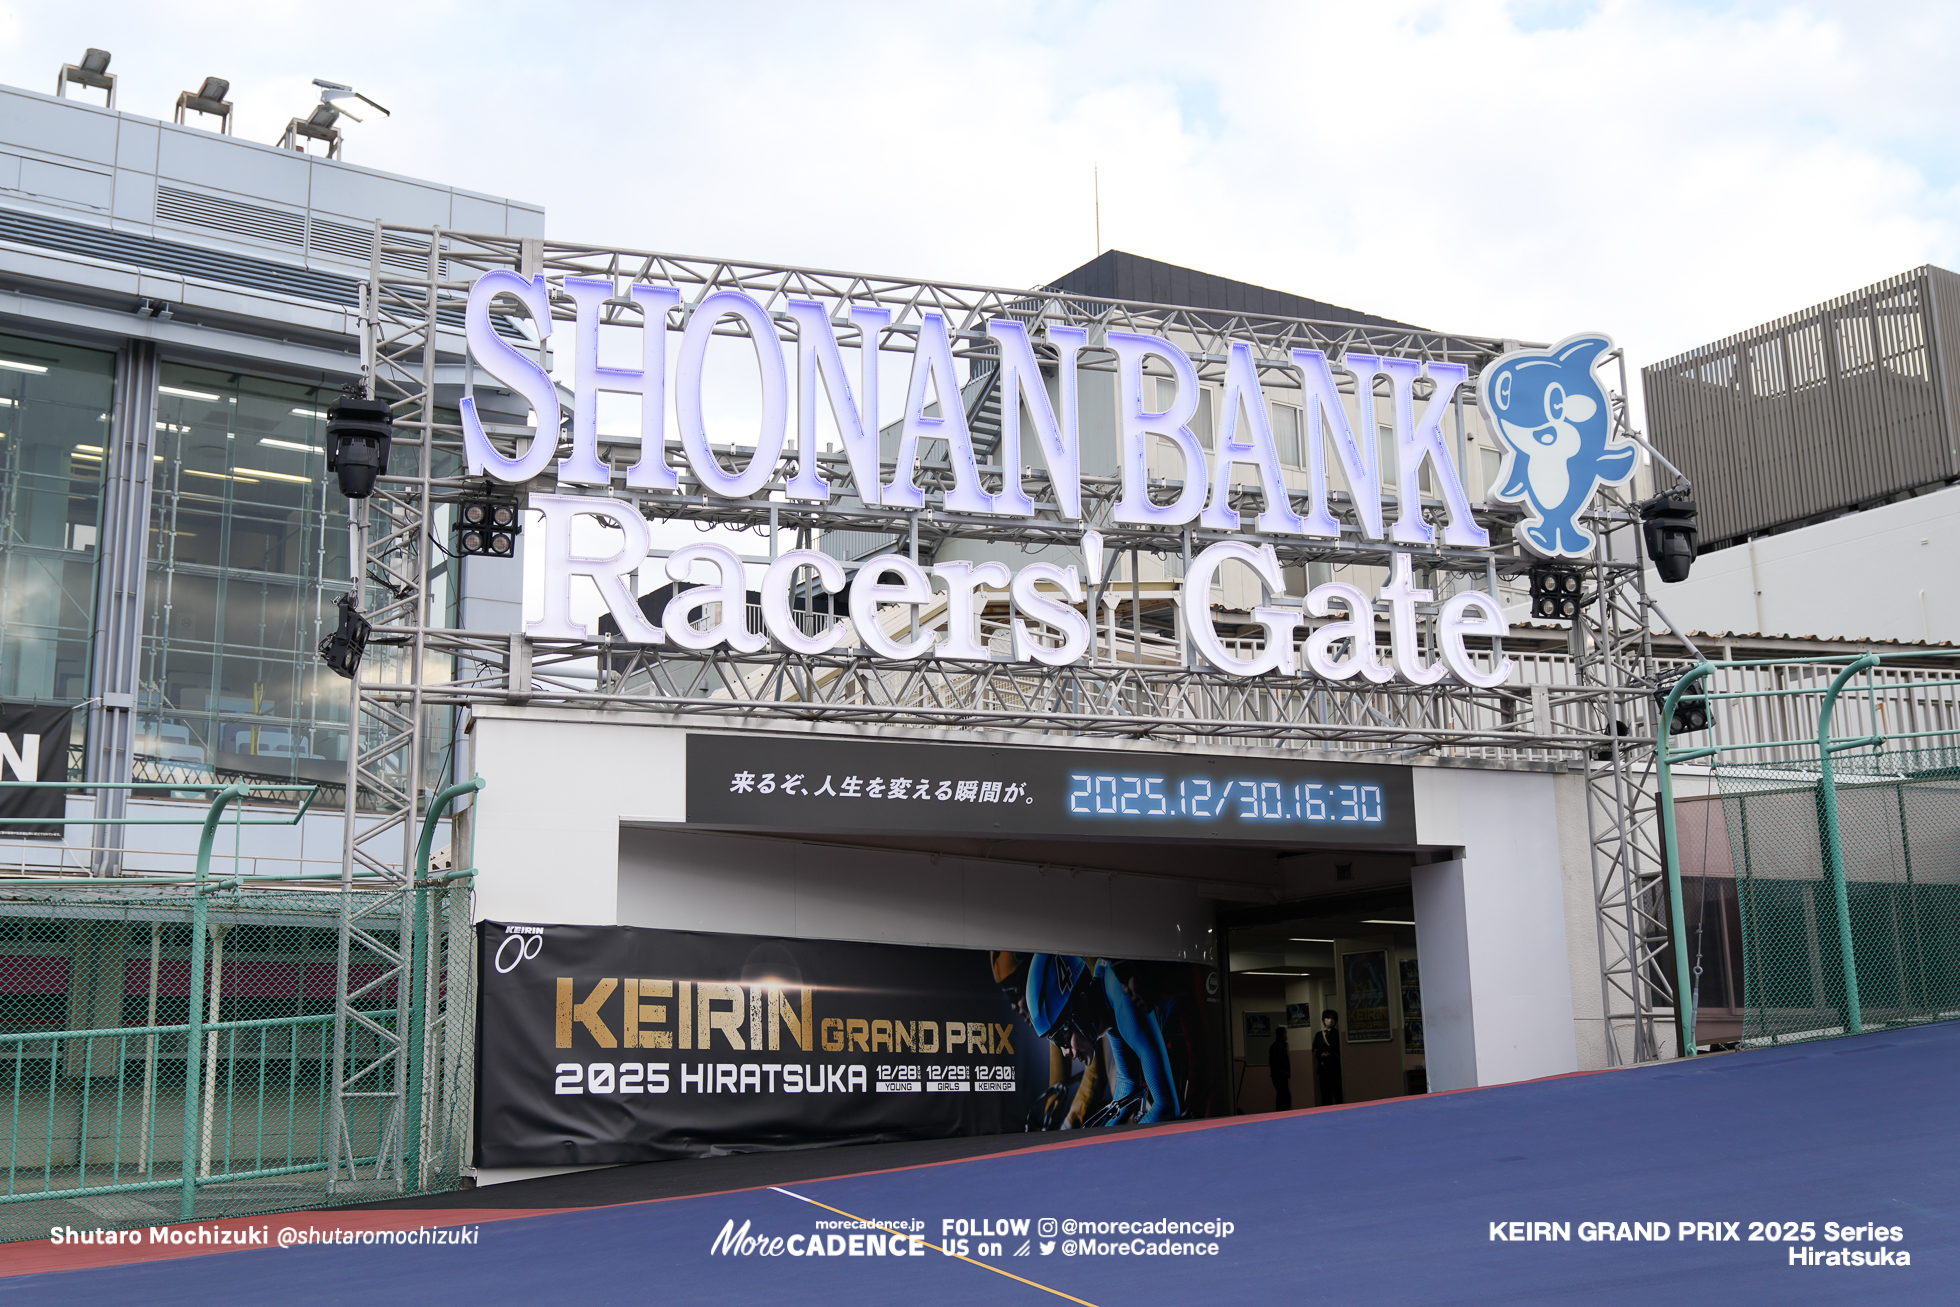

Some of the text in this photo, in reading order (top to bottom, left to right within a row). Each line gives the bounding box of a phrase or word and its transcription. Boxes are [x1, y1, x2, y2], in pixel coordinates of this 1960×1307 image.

[460, 268, 1490, 548] SHONAN BANK
[525, 492, 1515, 689] Racers' Gate
[730, 771, 1033, 805] 来るぞ、人生を変える瞬間が。
[505, 926, 544, 934] KEIRIN
[555, 976, 1015, 1055] KEIRIN GRAND PRIX
[555, 1062, 867, 1094] 2025 HIRATSUKA
[876, 1065, 917, 1080] 12/28
[926, 1065, 966, 1080] 12/29
[974, 1065, 1011, 1080] 12/30
[885, 1082, 912, 1091] YOUNG
[937, 1082, 960, 1090] GIRLS
